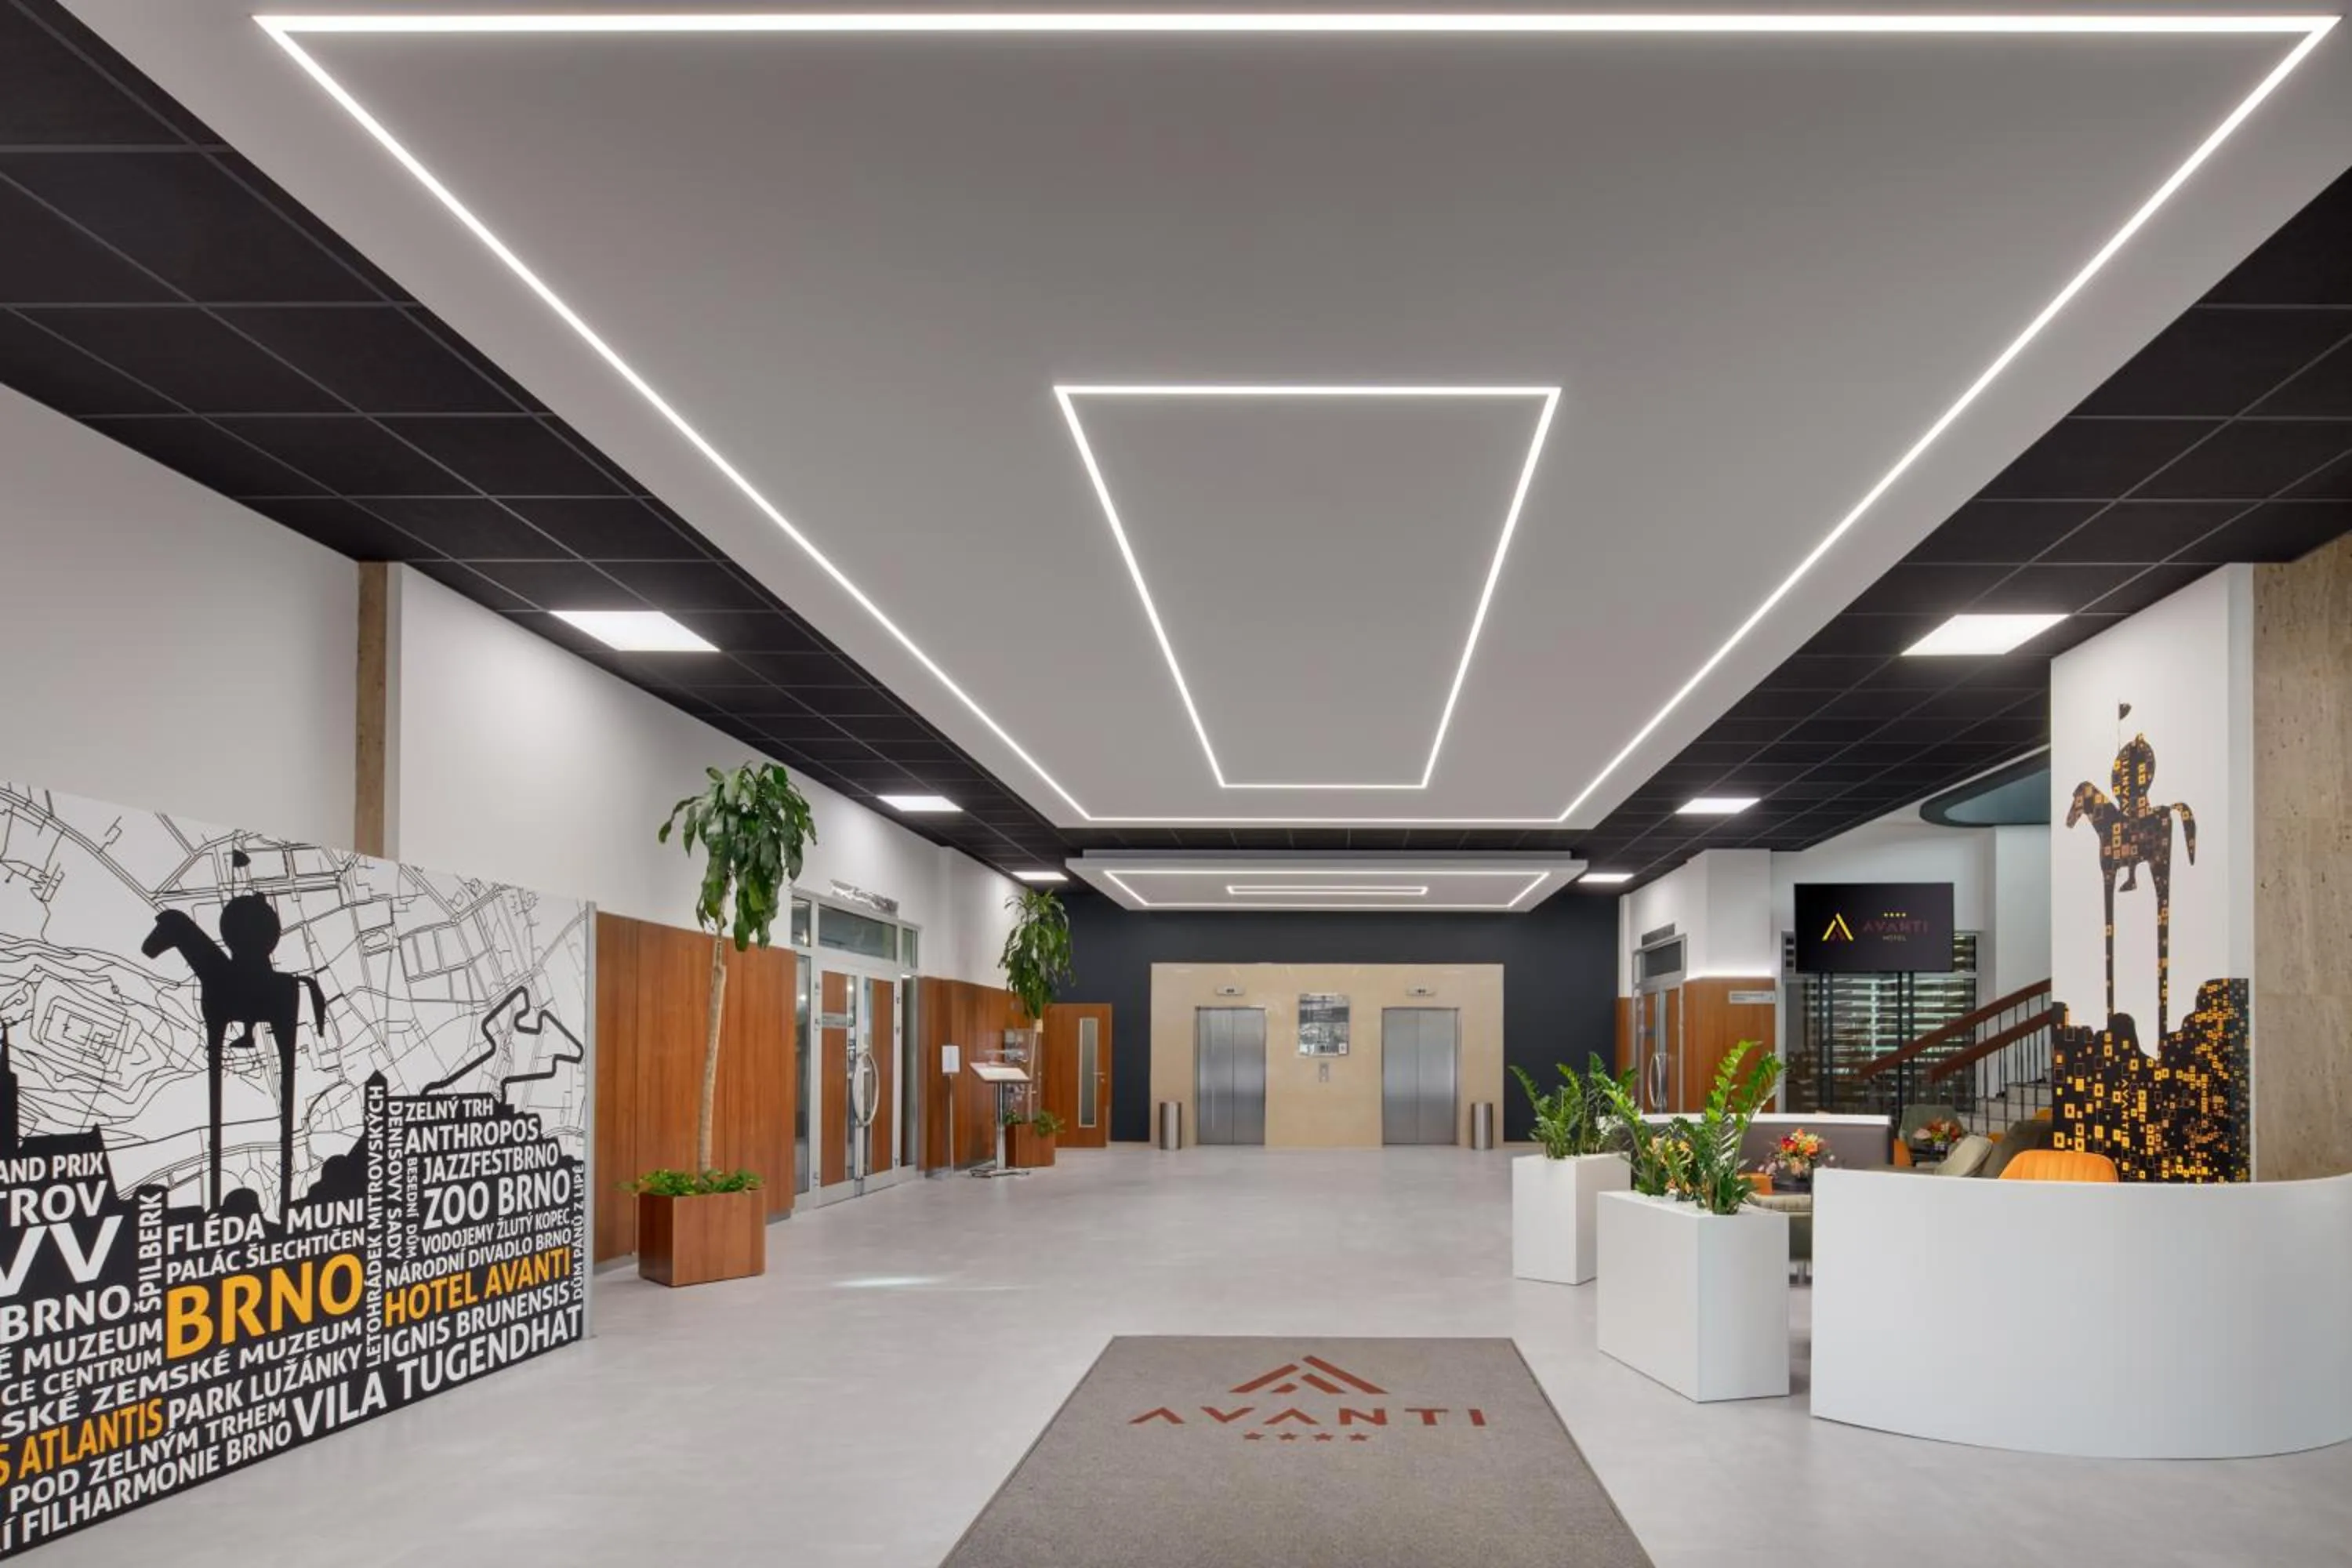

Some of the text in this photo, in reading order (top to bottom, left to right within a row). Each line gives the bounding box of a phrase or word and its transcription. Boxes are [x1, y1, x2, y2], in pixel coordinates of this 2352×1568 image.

[1863, 920, 1929, 935] AVANTI
[404, 1117, 539, 1155] ANTHROPOS
[405, 1095, 494, 1122] ZELNÝ TRH
[52, 1151, 105, 1180] PRIX
[387, 1101, 404, 1260] DENISOVY SADY
[423, 1142, 559, 1185] JAZZFESTBRNO
[167, 1198, 363, 1255] FLÉDA MUNI
[364, 1085, 384, 1368] LETOHRÁDEK MITROVSKÝCH
[405, 1156, 420, 1258] BESEDNÍ DŮM
[423, 1168, 571, 1230] ZOO BRNO
[573, 1202, 584, 1211] Z
[133, 1191, 163, 1314] ŠPILBERK
[167, 1227, 365, 1285] PALÁC ŠLECHTIČEN
[385, 1228, 572, 1289] NÁRODNÍ DIVADLO BRNO
[421, 1207, 570, 1255] VODOJEMY ŽLUTÝ KOPEC
[571, 1214, 583, 1258] PÁNŮ
[166, 1253, 364, 1359] BRNO
[384, 1246, 572, 1327] HOTEL AVANTI
[571, 1261, 583, 1301] DŮM
[0, 1285, 131, 1345] BRNO
[383, 1280, 570, 1362] IGNIS BRUNENSIS
[23, 1318, 163, 1376] MUZEUM
[43, 1348, 162, 1396] CENTRUM
[292, 1304, 583, 1438] VILA TUGENDHAT
[1, 1316, 363, 1439] SKÉ ZEMSKÉ MUZEUM
[168, 1343, 363, 1429] PARK LUŽÁNKY
[18, 1398, 164, 1479] ATLANTIS
[1129, 1406, 1486, 1427] AVANTI
[10, 1398, 286, 1513] POD ZELNÝM TRHEM
[23, 1446, 221, 1544] FILHARMONIE
[226, 1421, 292, 1467] BRNO
